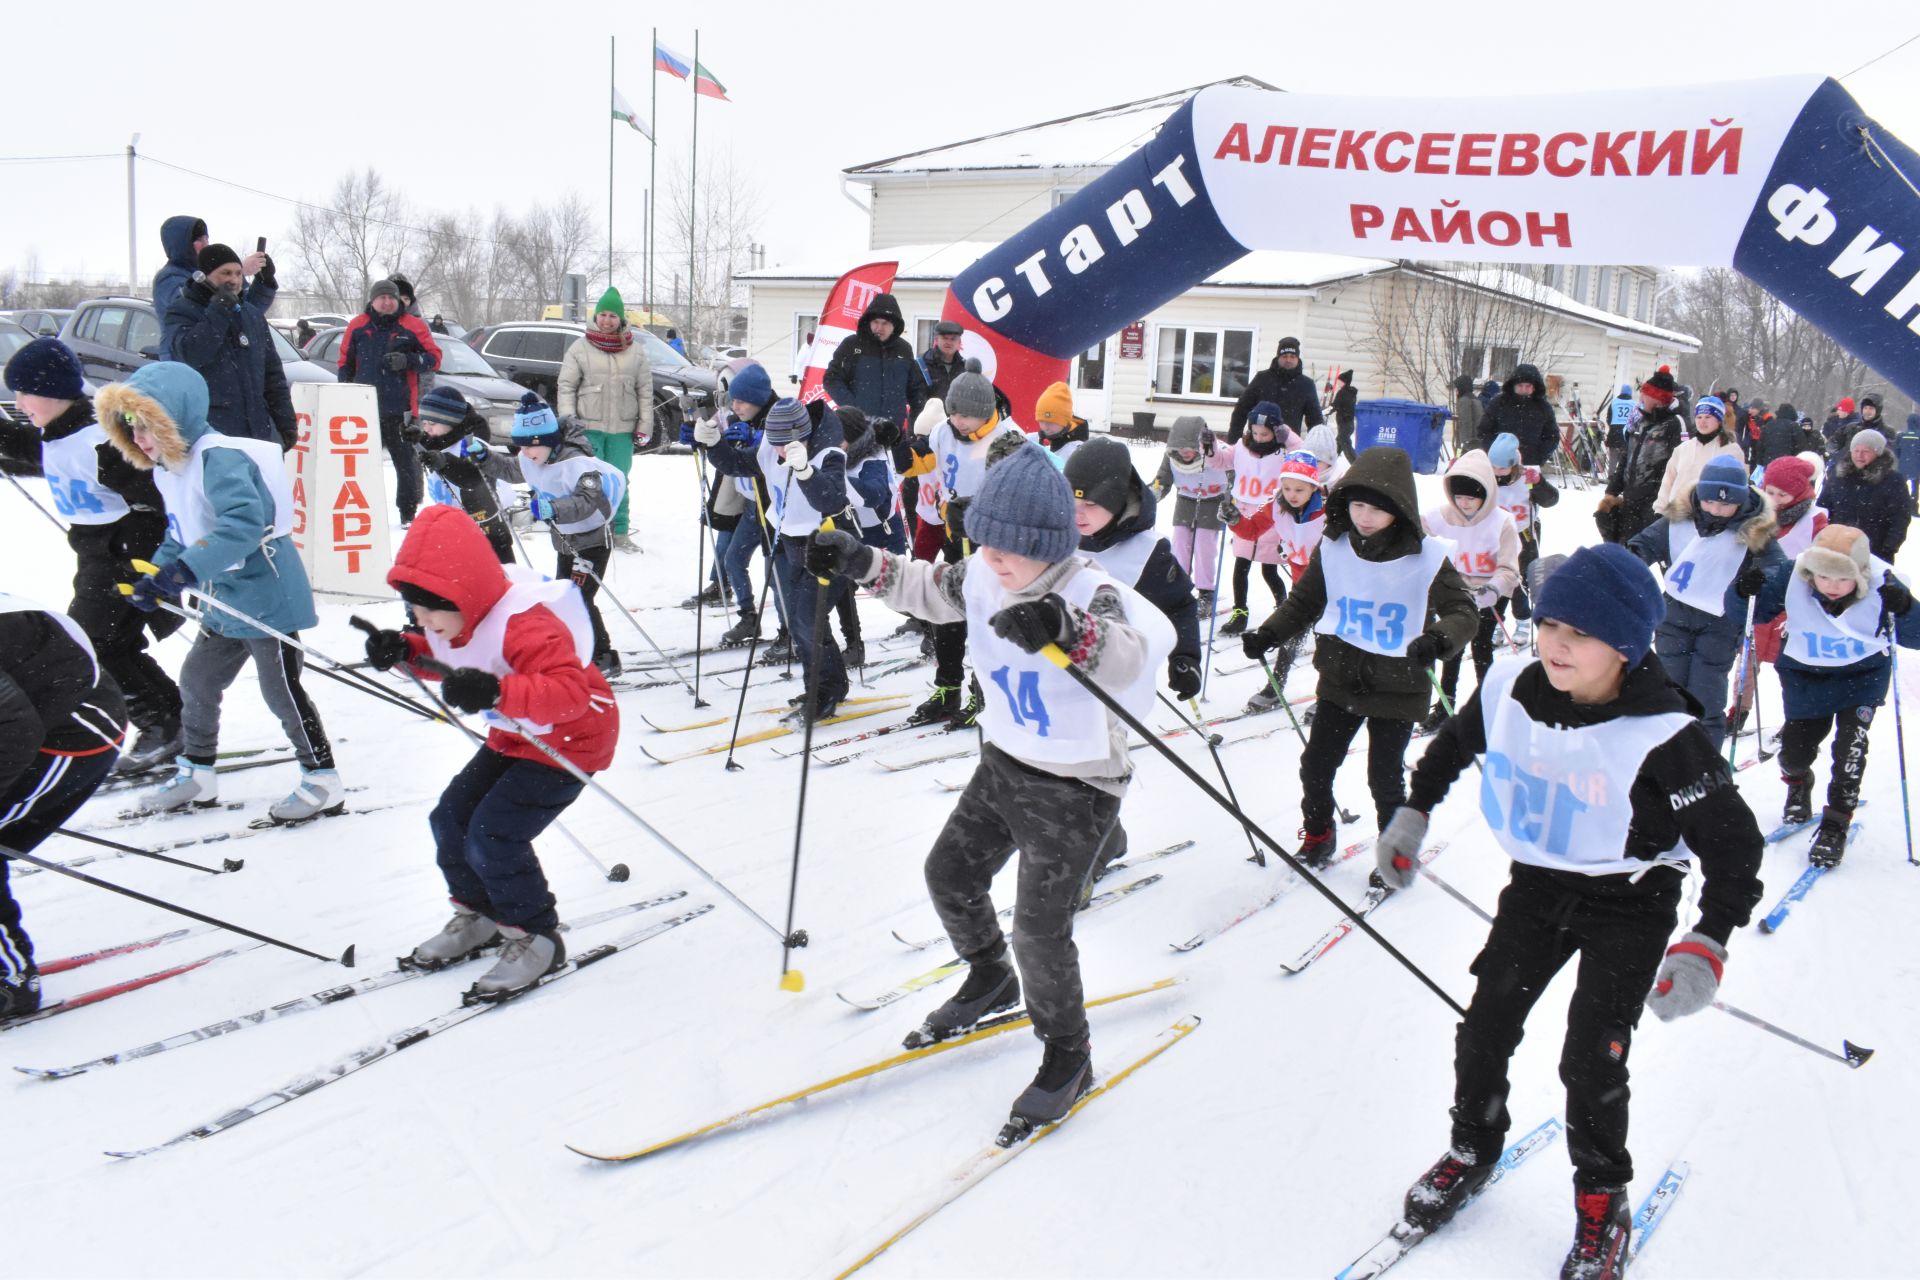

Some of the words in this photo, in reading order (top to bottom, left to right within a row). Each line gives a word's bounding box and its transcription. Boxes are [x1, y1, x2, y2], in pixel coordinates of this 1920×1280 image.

[1213, 118, 1743, 177] АЛЕКСЕЕВСКИЙ
[1350, 199, 1572, 248] РАЙОН
[1617, 407, 1630, 418] 32
[292, 413, 312, 550] СТАР
[329, 415, 373, 574] СТАРТ
[944, 453, 959, 489] 3
[1239, 475, 1279, 498] 104
[1670, 561, 1695, 593] 4
[1335, 596, 1408, 651] 153
[990, 665, 1051, 737] 14
